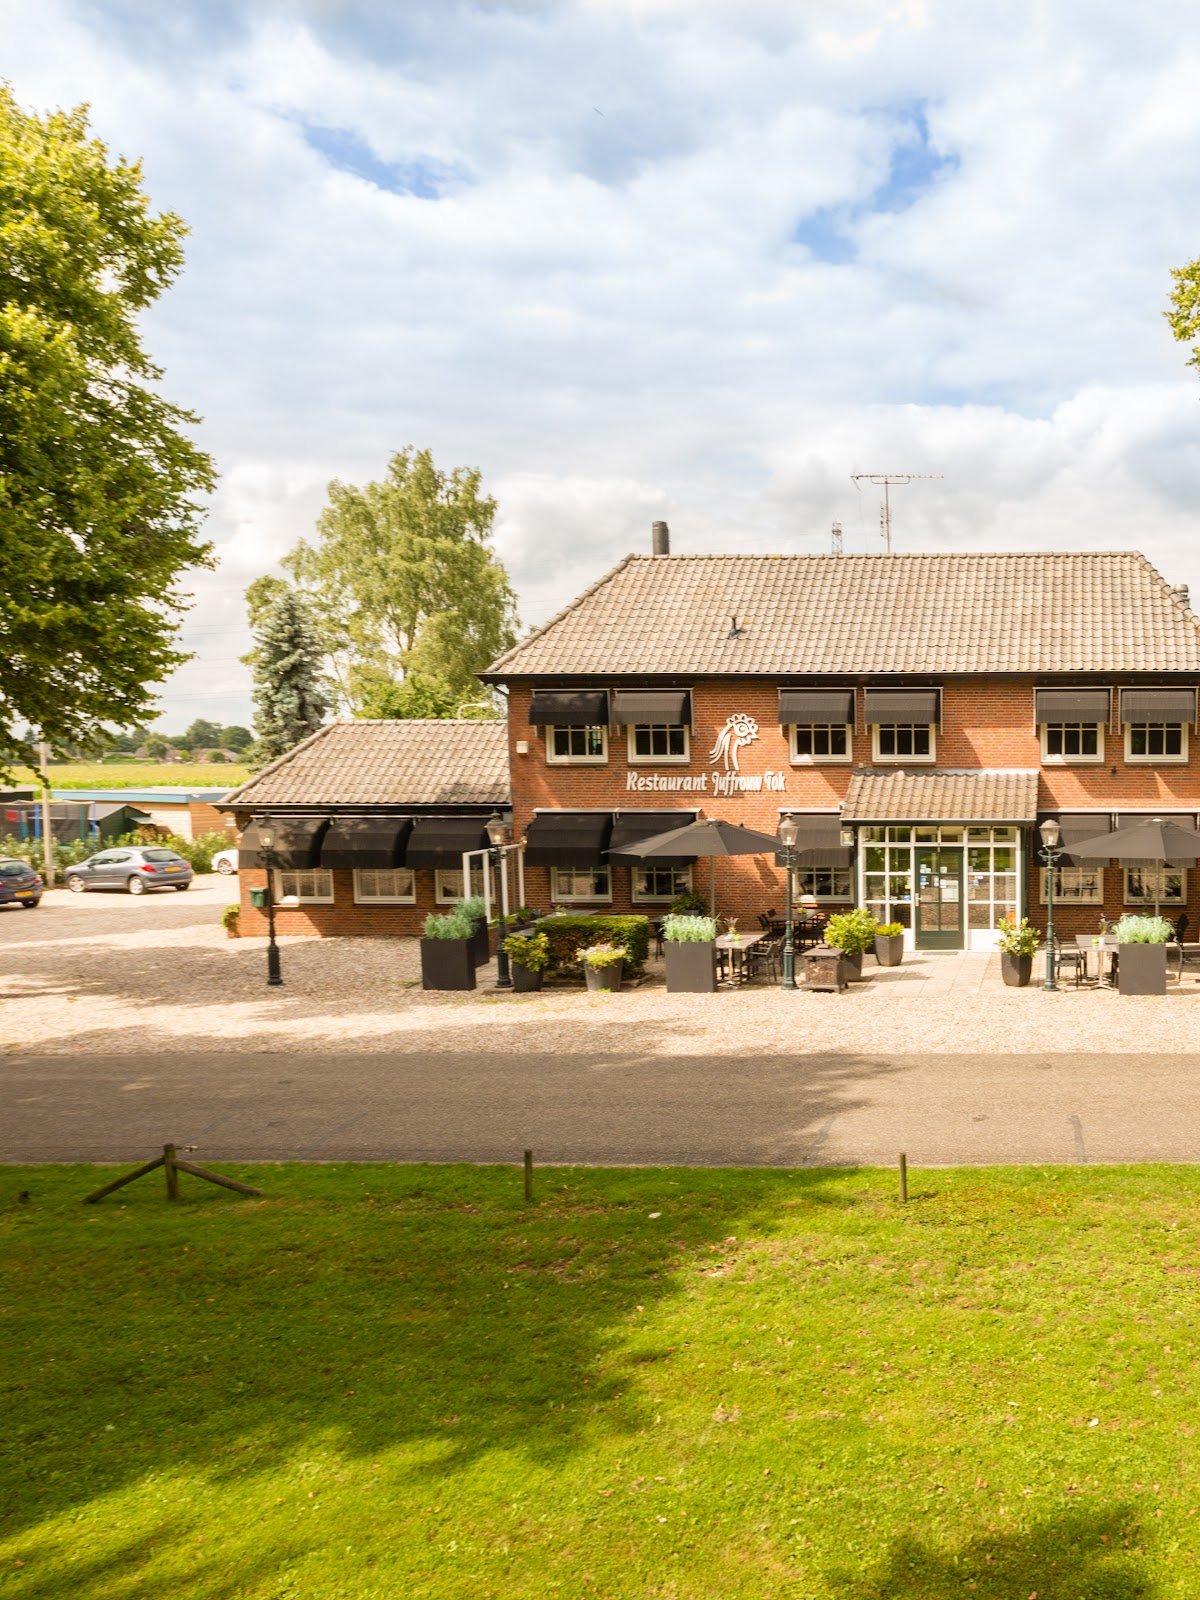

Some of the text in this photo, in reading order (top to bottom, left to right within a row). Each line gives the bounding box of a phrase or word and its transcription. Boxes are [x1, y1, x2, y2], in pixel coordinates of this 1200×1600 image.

[626, 770, 787, 797] Restaurant Juffrouw Tok
